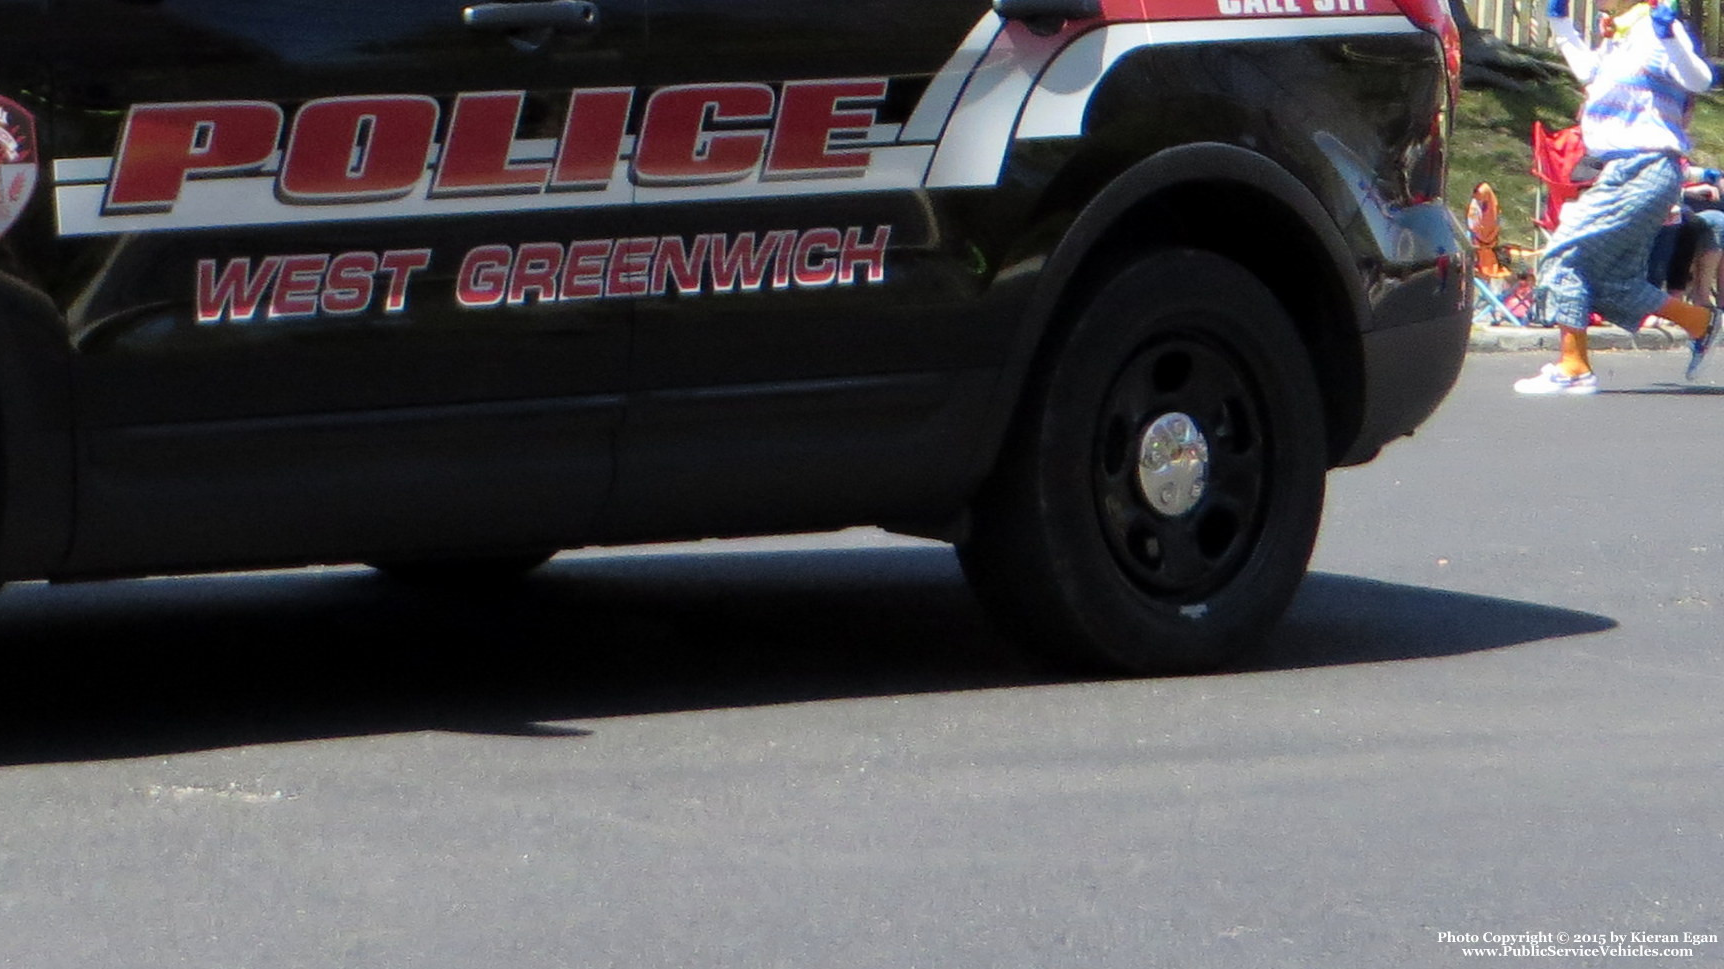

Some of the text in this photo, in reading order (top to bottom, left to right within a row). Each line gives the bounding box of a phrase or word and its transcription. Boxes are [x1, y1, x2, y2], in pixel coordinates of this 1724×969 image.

[104, 78, 889, 215] POLICE
[195, 226, 891, 322] WEST GREENWICH
